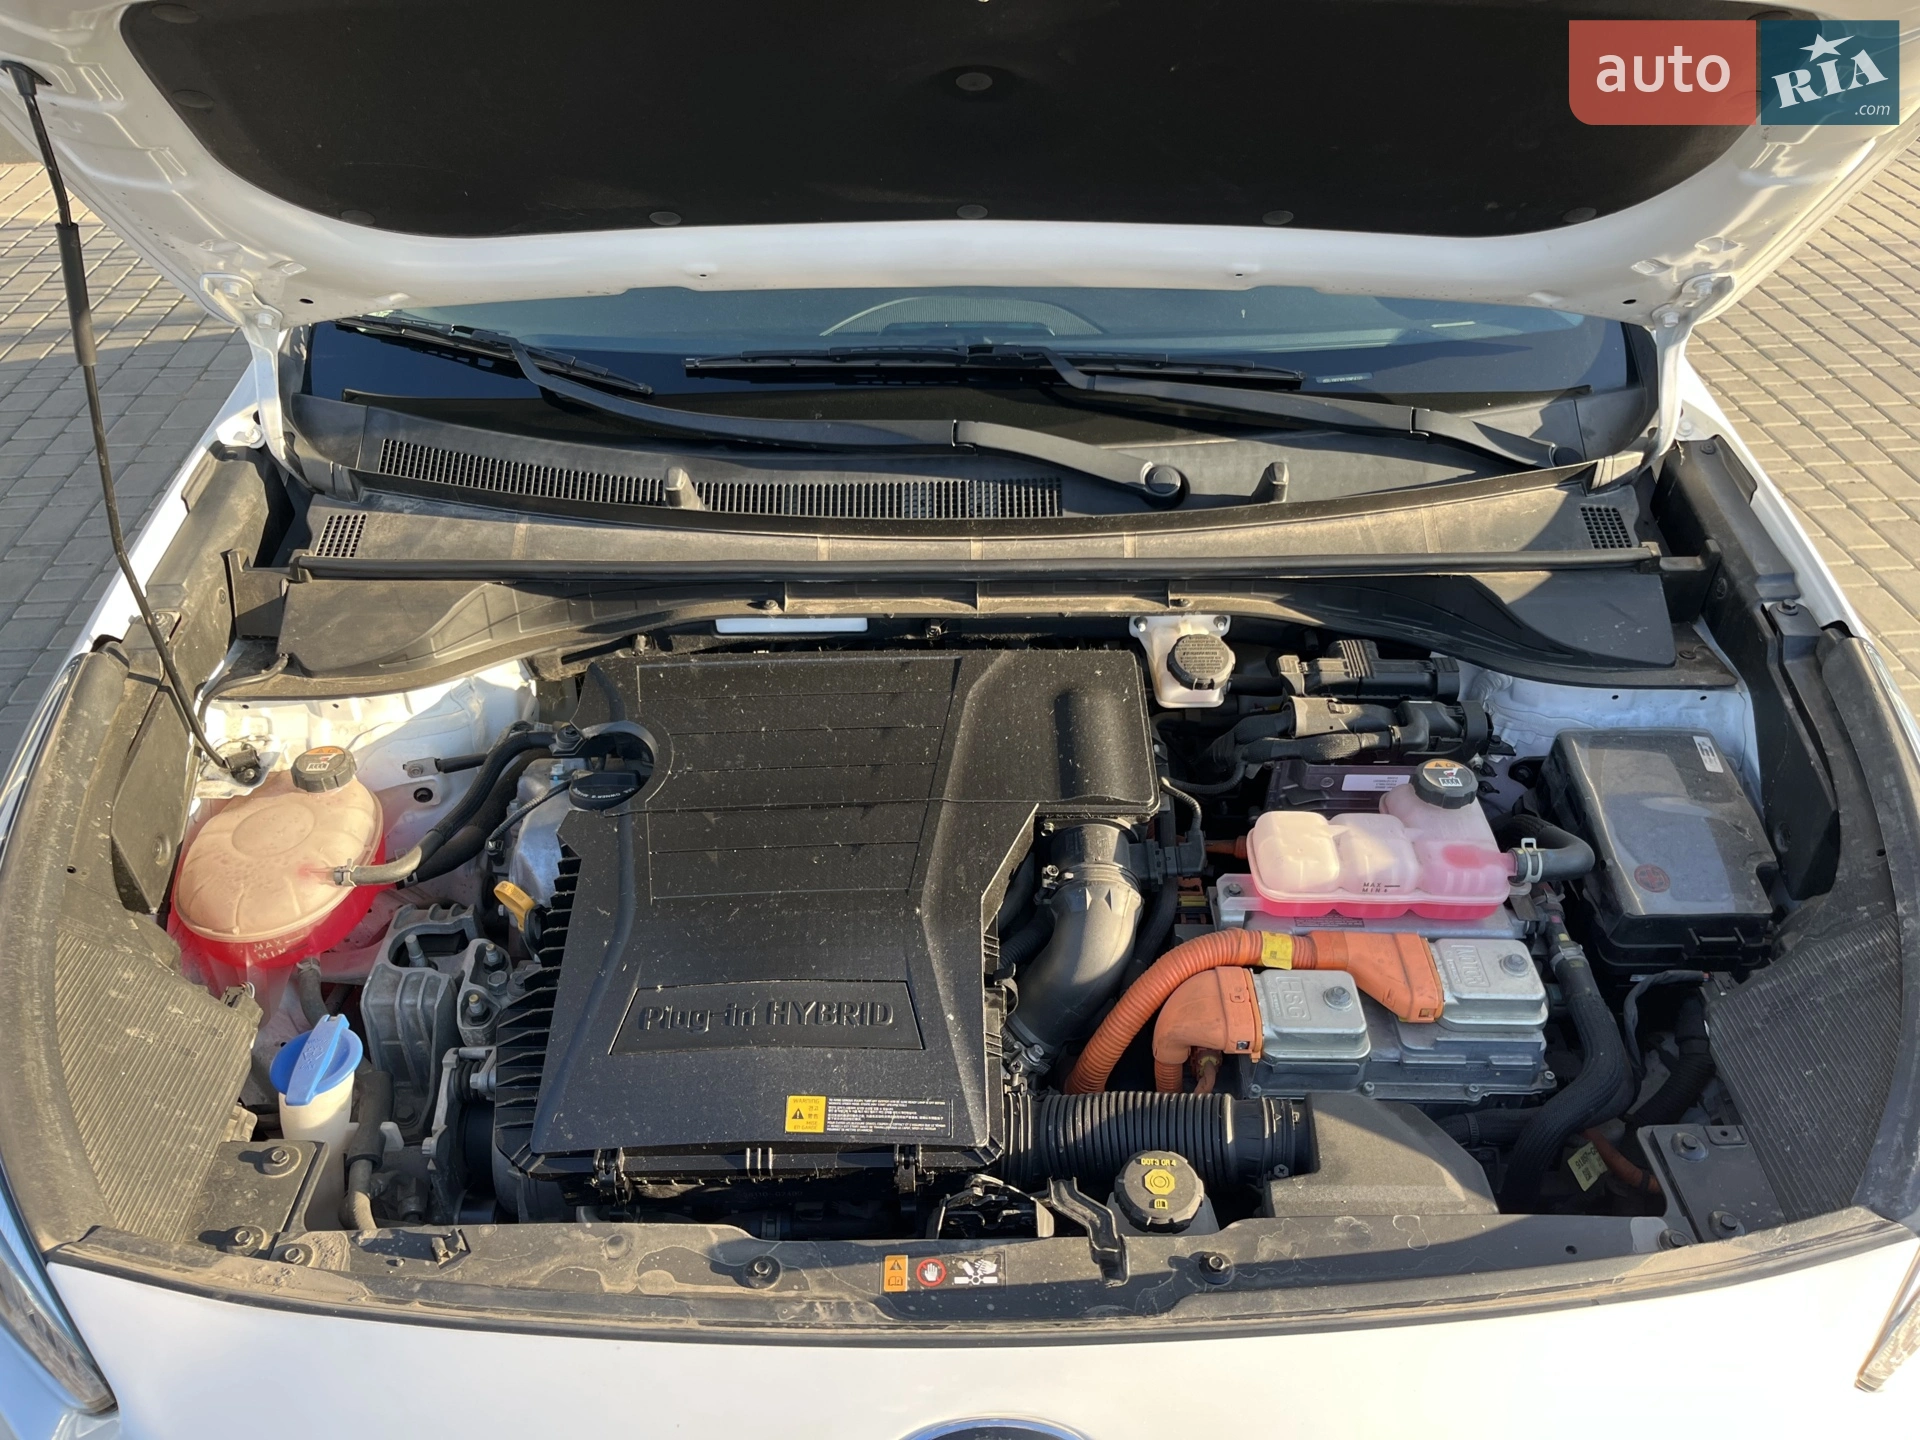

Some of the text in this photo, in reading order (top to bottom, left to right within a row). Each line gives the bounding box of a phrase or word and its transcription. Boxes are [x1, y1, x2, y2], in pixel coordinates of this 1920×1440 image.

[254, 939, 283, 950] MAX
[258, 948, 286, 959] MIN
[1281, 981, 1307, 1018] HSG
[640, 1001, 894, 1034] Plug-in HYBRID
[1160, 1158, 1171, 1166] OR
[1170, 1159, 1177, 1167] 4
